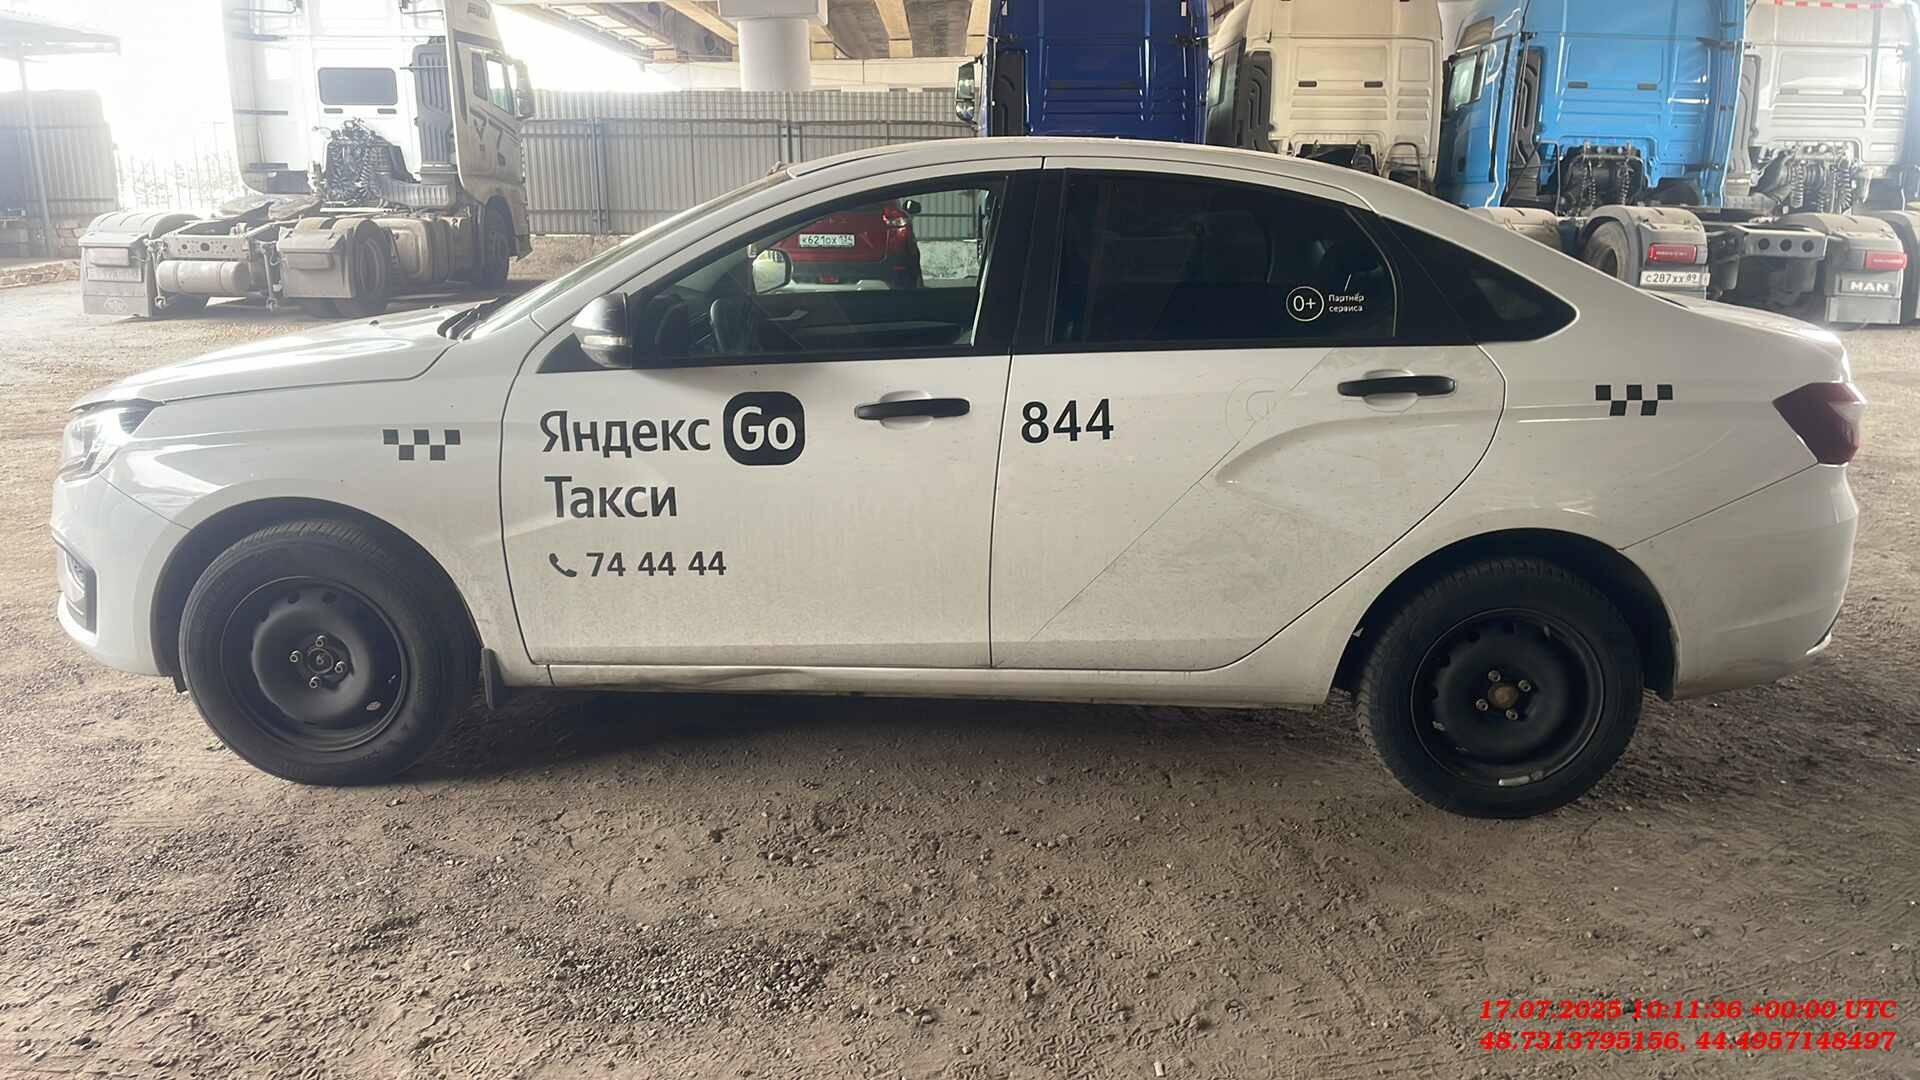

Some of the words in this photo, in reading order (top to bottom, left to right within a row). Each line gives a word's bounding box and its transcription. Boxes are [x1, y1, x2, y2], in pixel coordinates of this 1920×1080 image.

[1850, 281, 1889, 292] MAN
[1328, 305, 1363, 313] сервиса
[539, 410, 711, 459] Яндекс
[732, 406, 796, 451] Go
[1021, 398, 1115, 444] 844
[544, 475, 677, 519] Такси
[586, 552, 626, 577] 74
[637, 551, 677, 577] 44
[687, 550, 727, 576] 44
